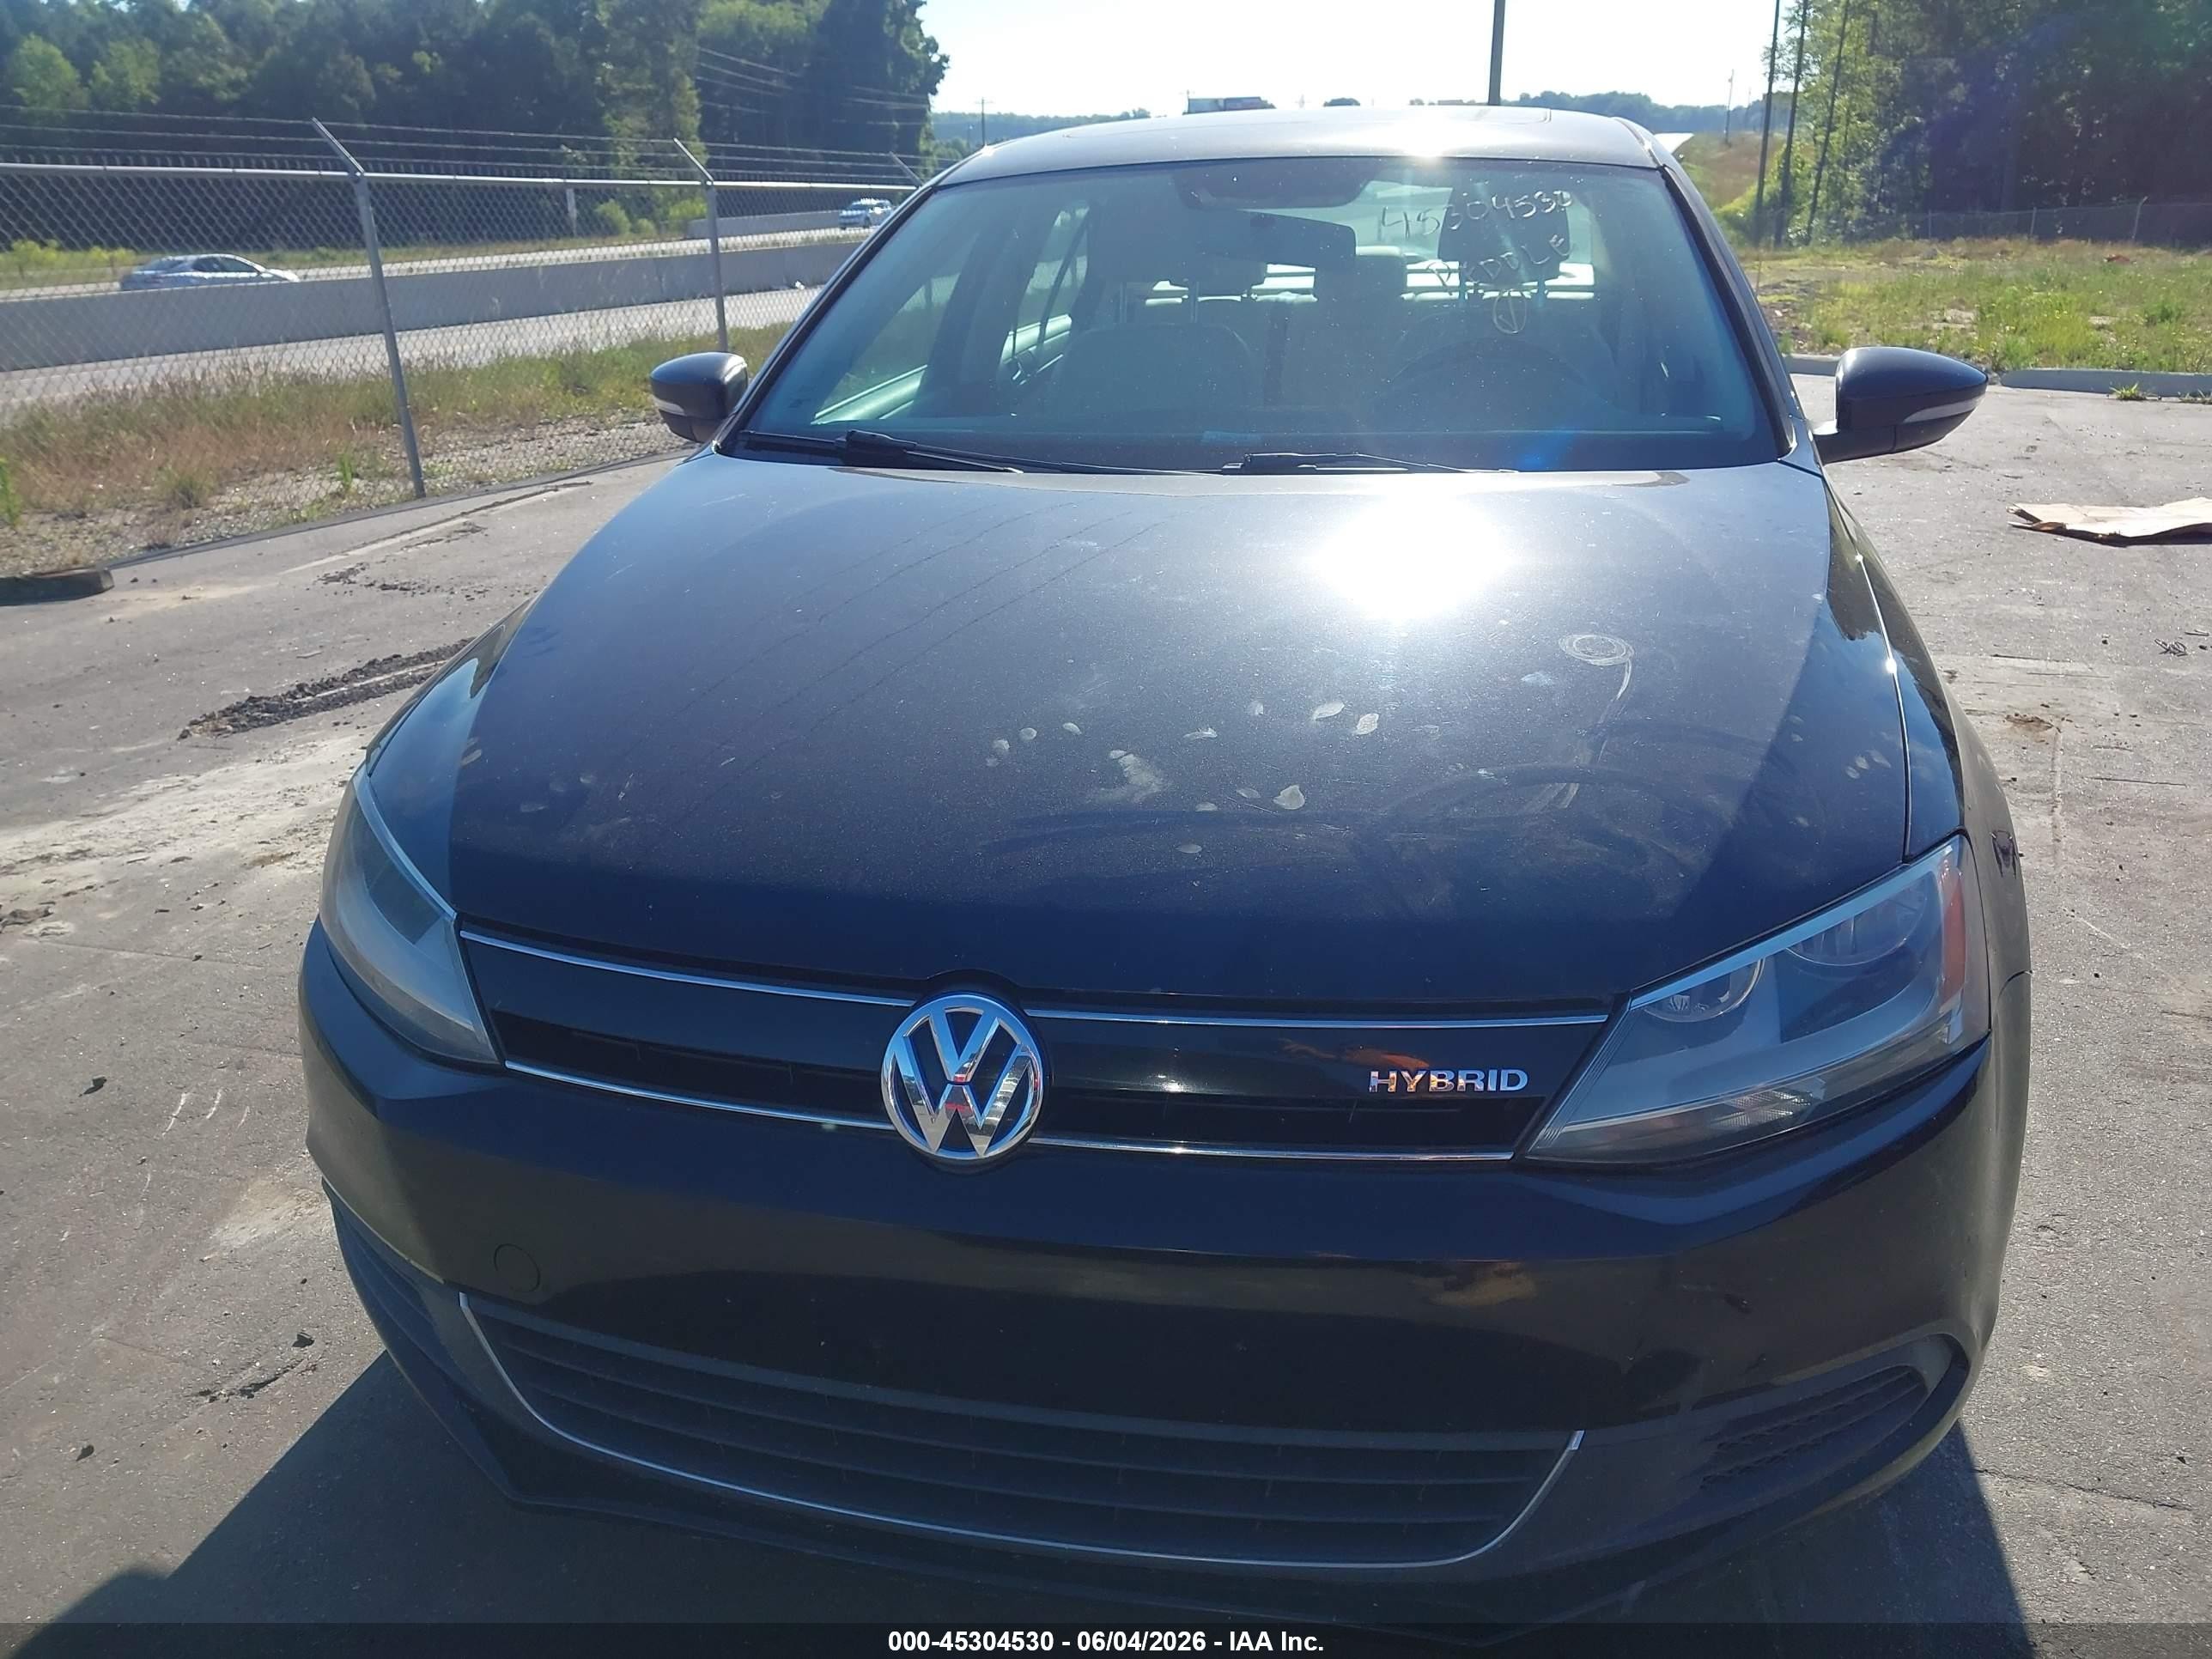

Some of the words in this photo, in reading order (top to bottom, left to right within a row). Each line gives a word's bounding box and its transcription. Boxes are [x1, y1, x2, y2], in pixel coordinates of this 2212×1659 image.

[1380, 190, 1572, 240] 45304530
[883, 996, 1042, 1158] VW
[1370, 1069, 1529, 1092] HYBRID
